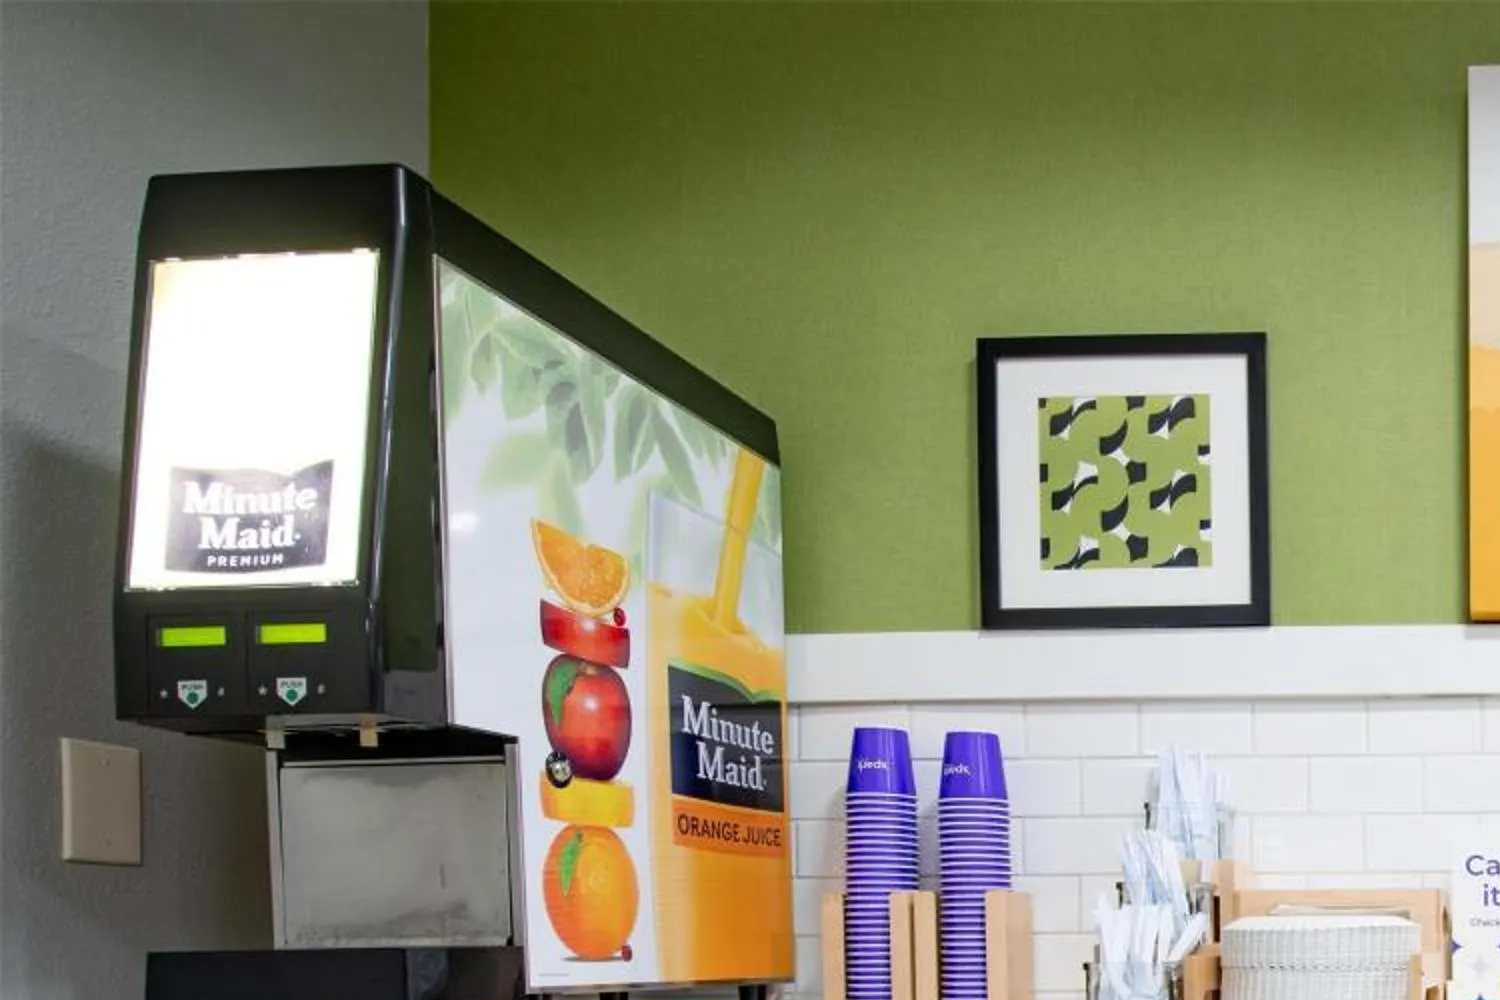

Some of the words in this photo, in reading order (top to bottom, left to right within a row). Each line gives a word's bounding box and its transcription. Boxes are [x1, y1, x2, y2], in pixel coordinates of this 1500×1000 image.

[182, 480, 318, 514] Minute
[197, 514, 296, 550] Maid
[206, 553, 284, 567] PREMIUM
[680, 694, 775, 755] Minute
[695, 740, 765, 791] Maid
[677, 813, 740, 843] ORANGE
[741, 822, 782, 847] JUICE
[1469, 917, 1500, 927] Check
